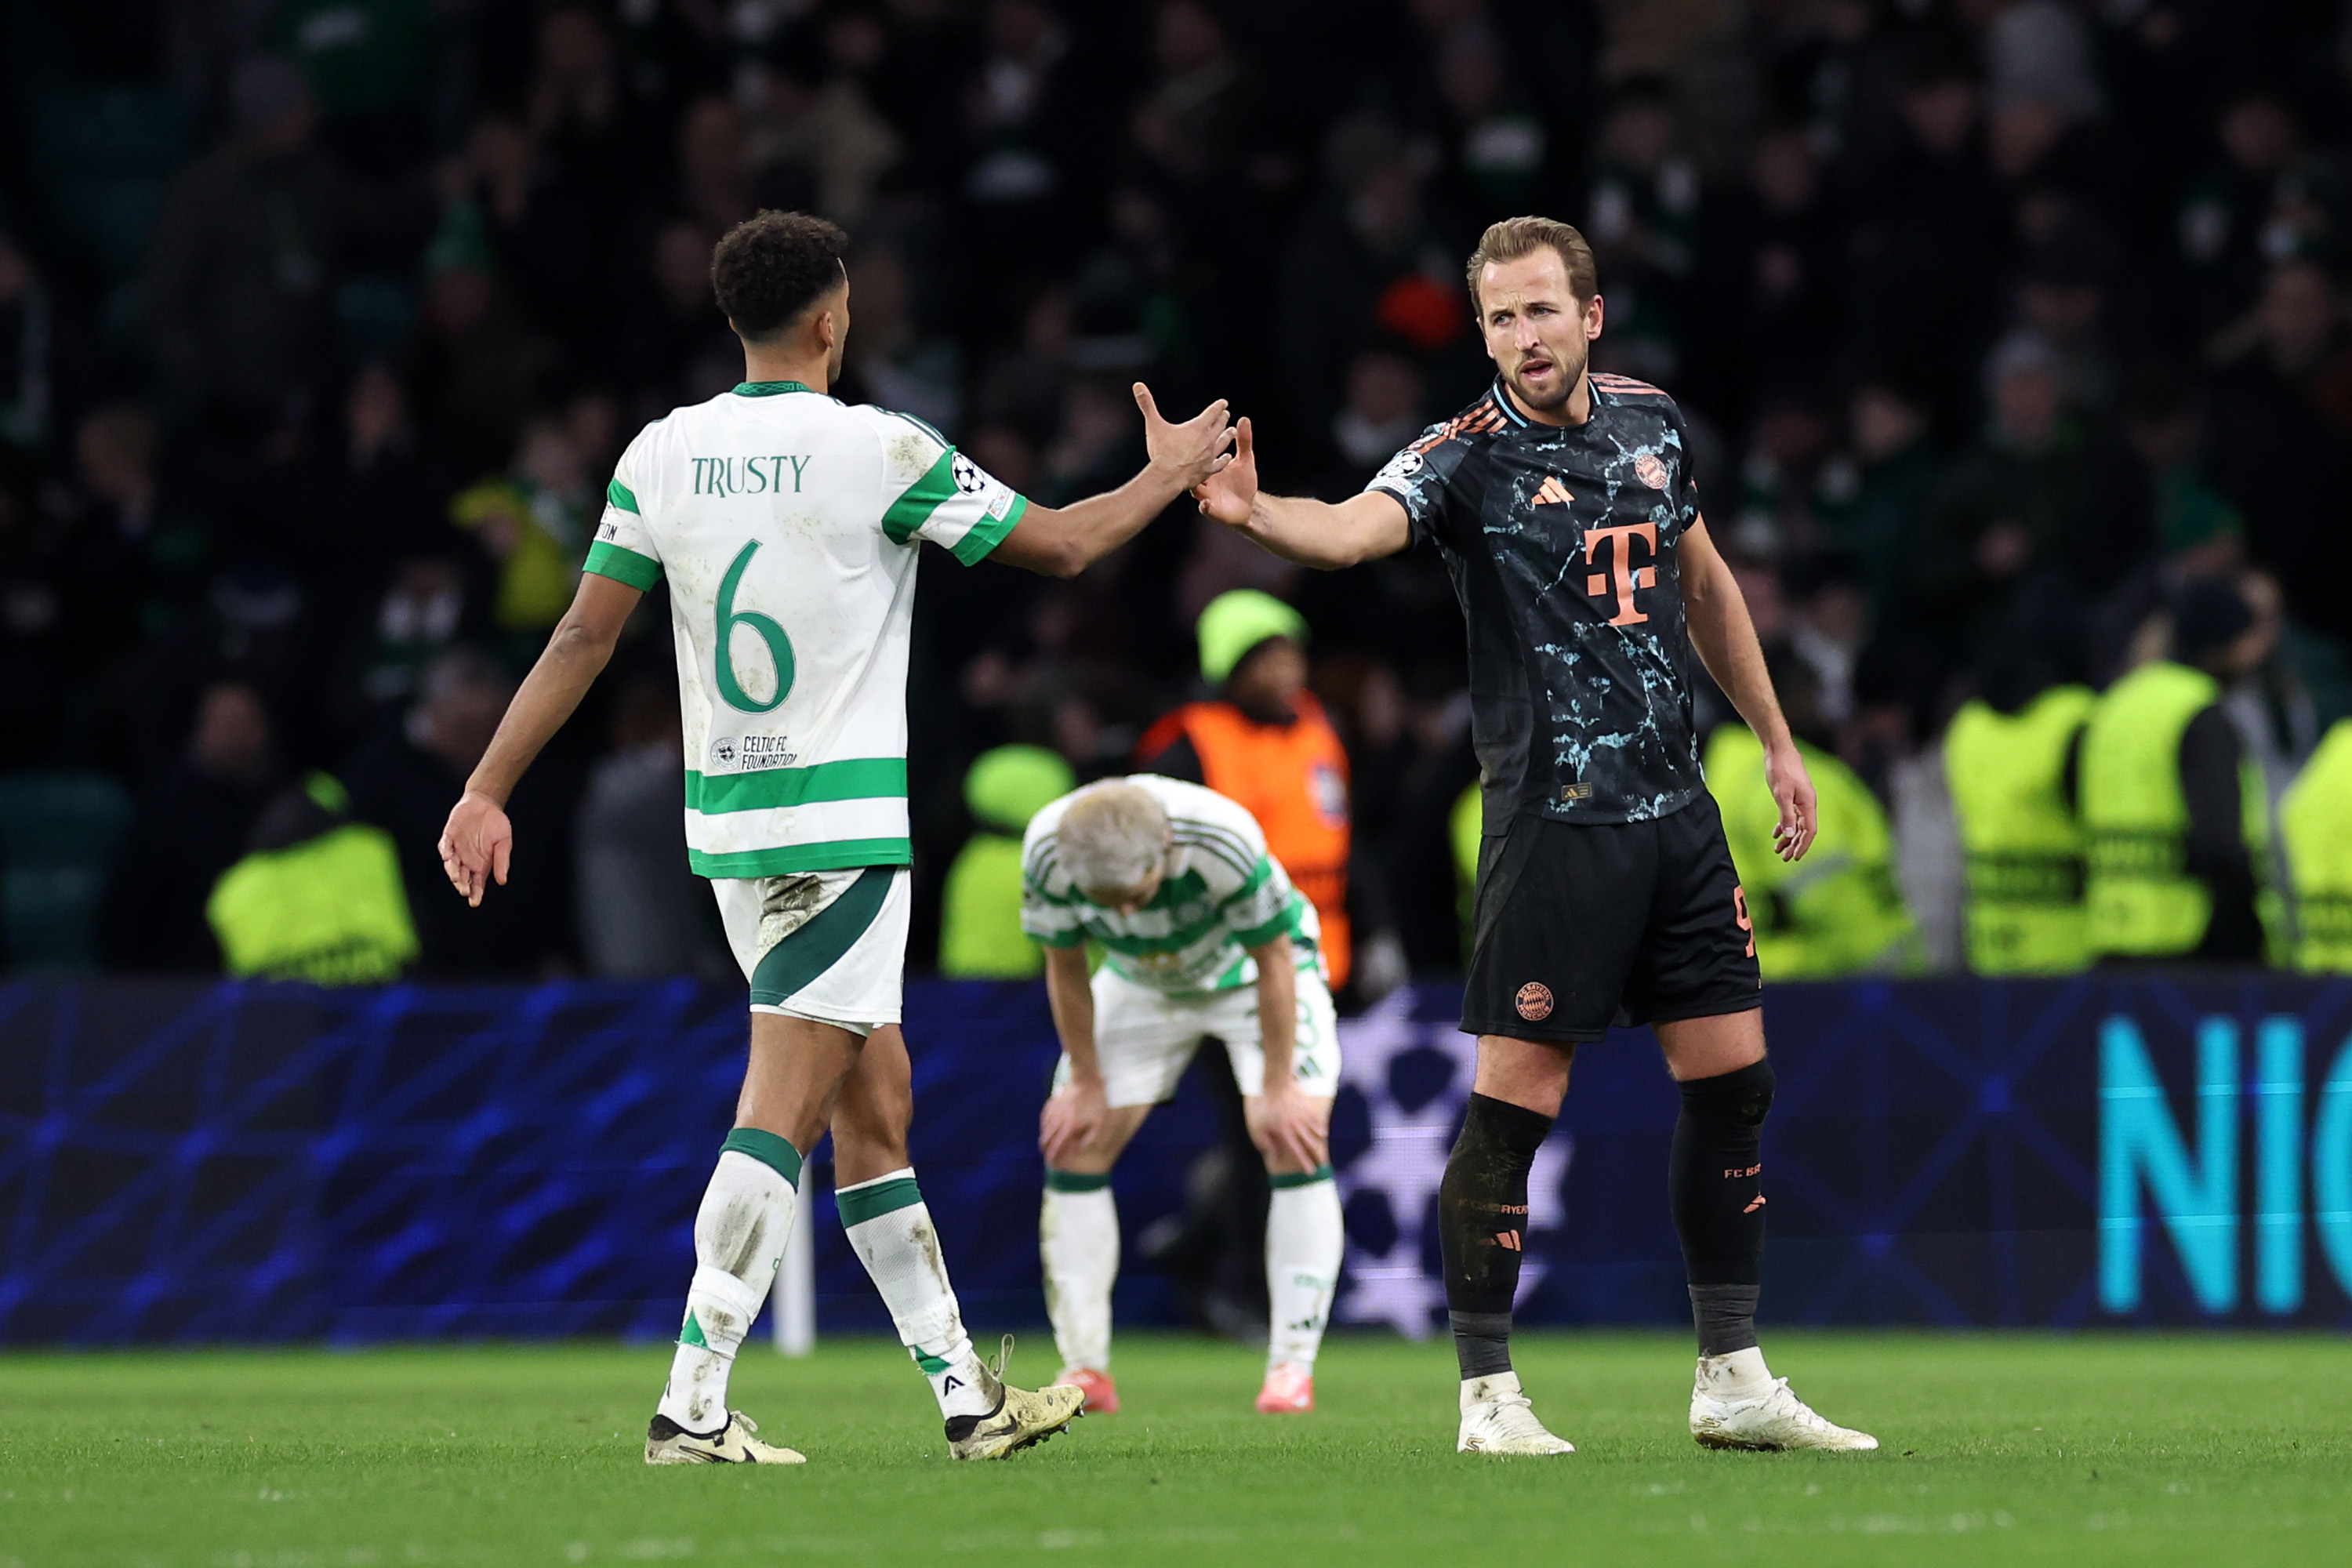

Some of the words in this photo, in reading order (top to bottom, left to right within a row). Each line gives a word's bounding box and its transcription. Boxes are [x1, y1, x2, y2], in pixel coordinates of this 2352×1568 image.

[691, 455, 812, 499] TRUSTY
[1584, 522, 1657, 626] T
[714, 538, 797, 715] 6
[743, 735, 775, 753] CELTIC
[775, 735, 788, 752] FC
[1723, 1168, 1744, 1180] FC
